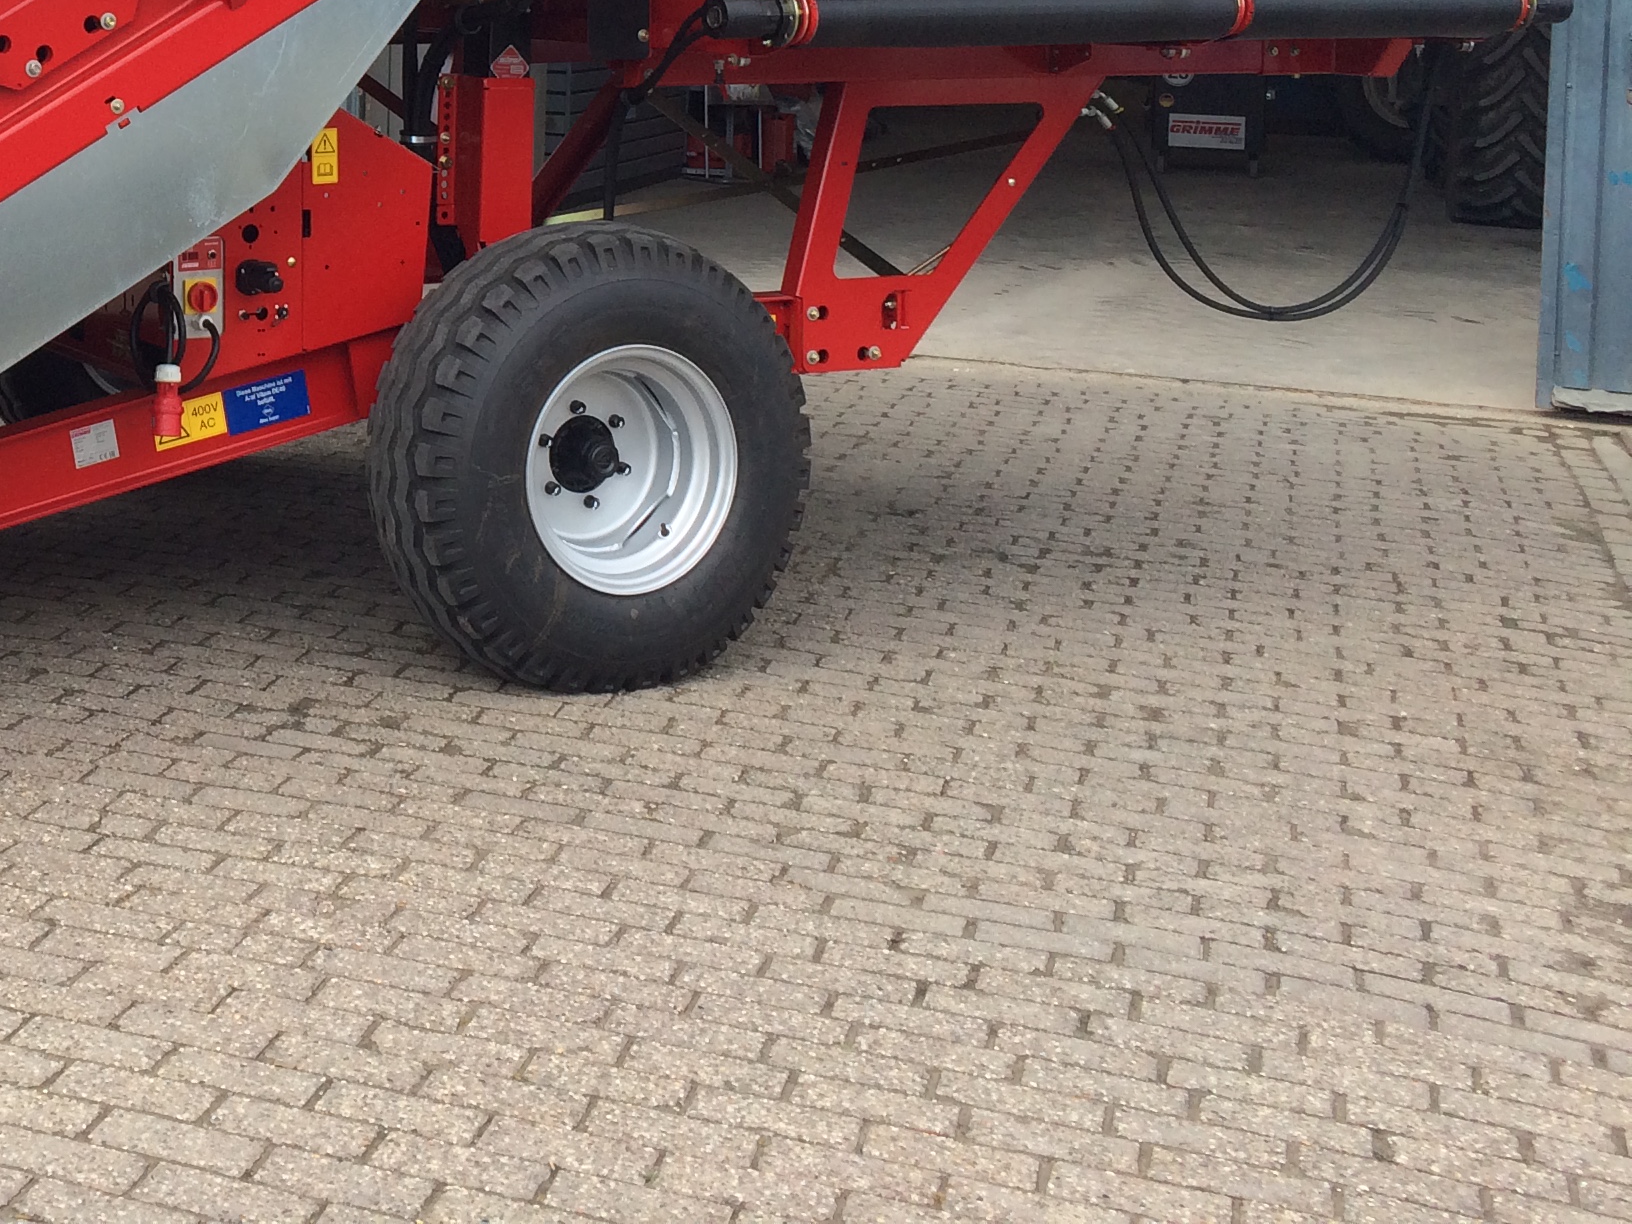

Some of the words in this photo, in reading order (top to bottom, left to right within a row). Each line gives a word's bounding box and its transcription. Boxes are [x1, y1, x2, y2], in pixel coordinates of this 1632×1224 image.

[1169, 120, 1242, 136] GRIMME
[191, 401, 219, 418] 400V
[199, 417, 216, 431] AC
